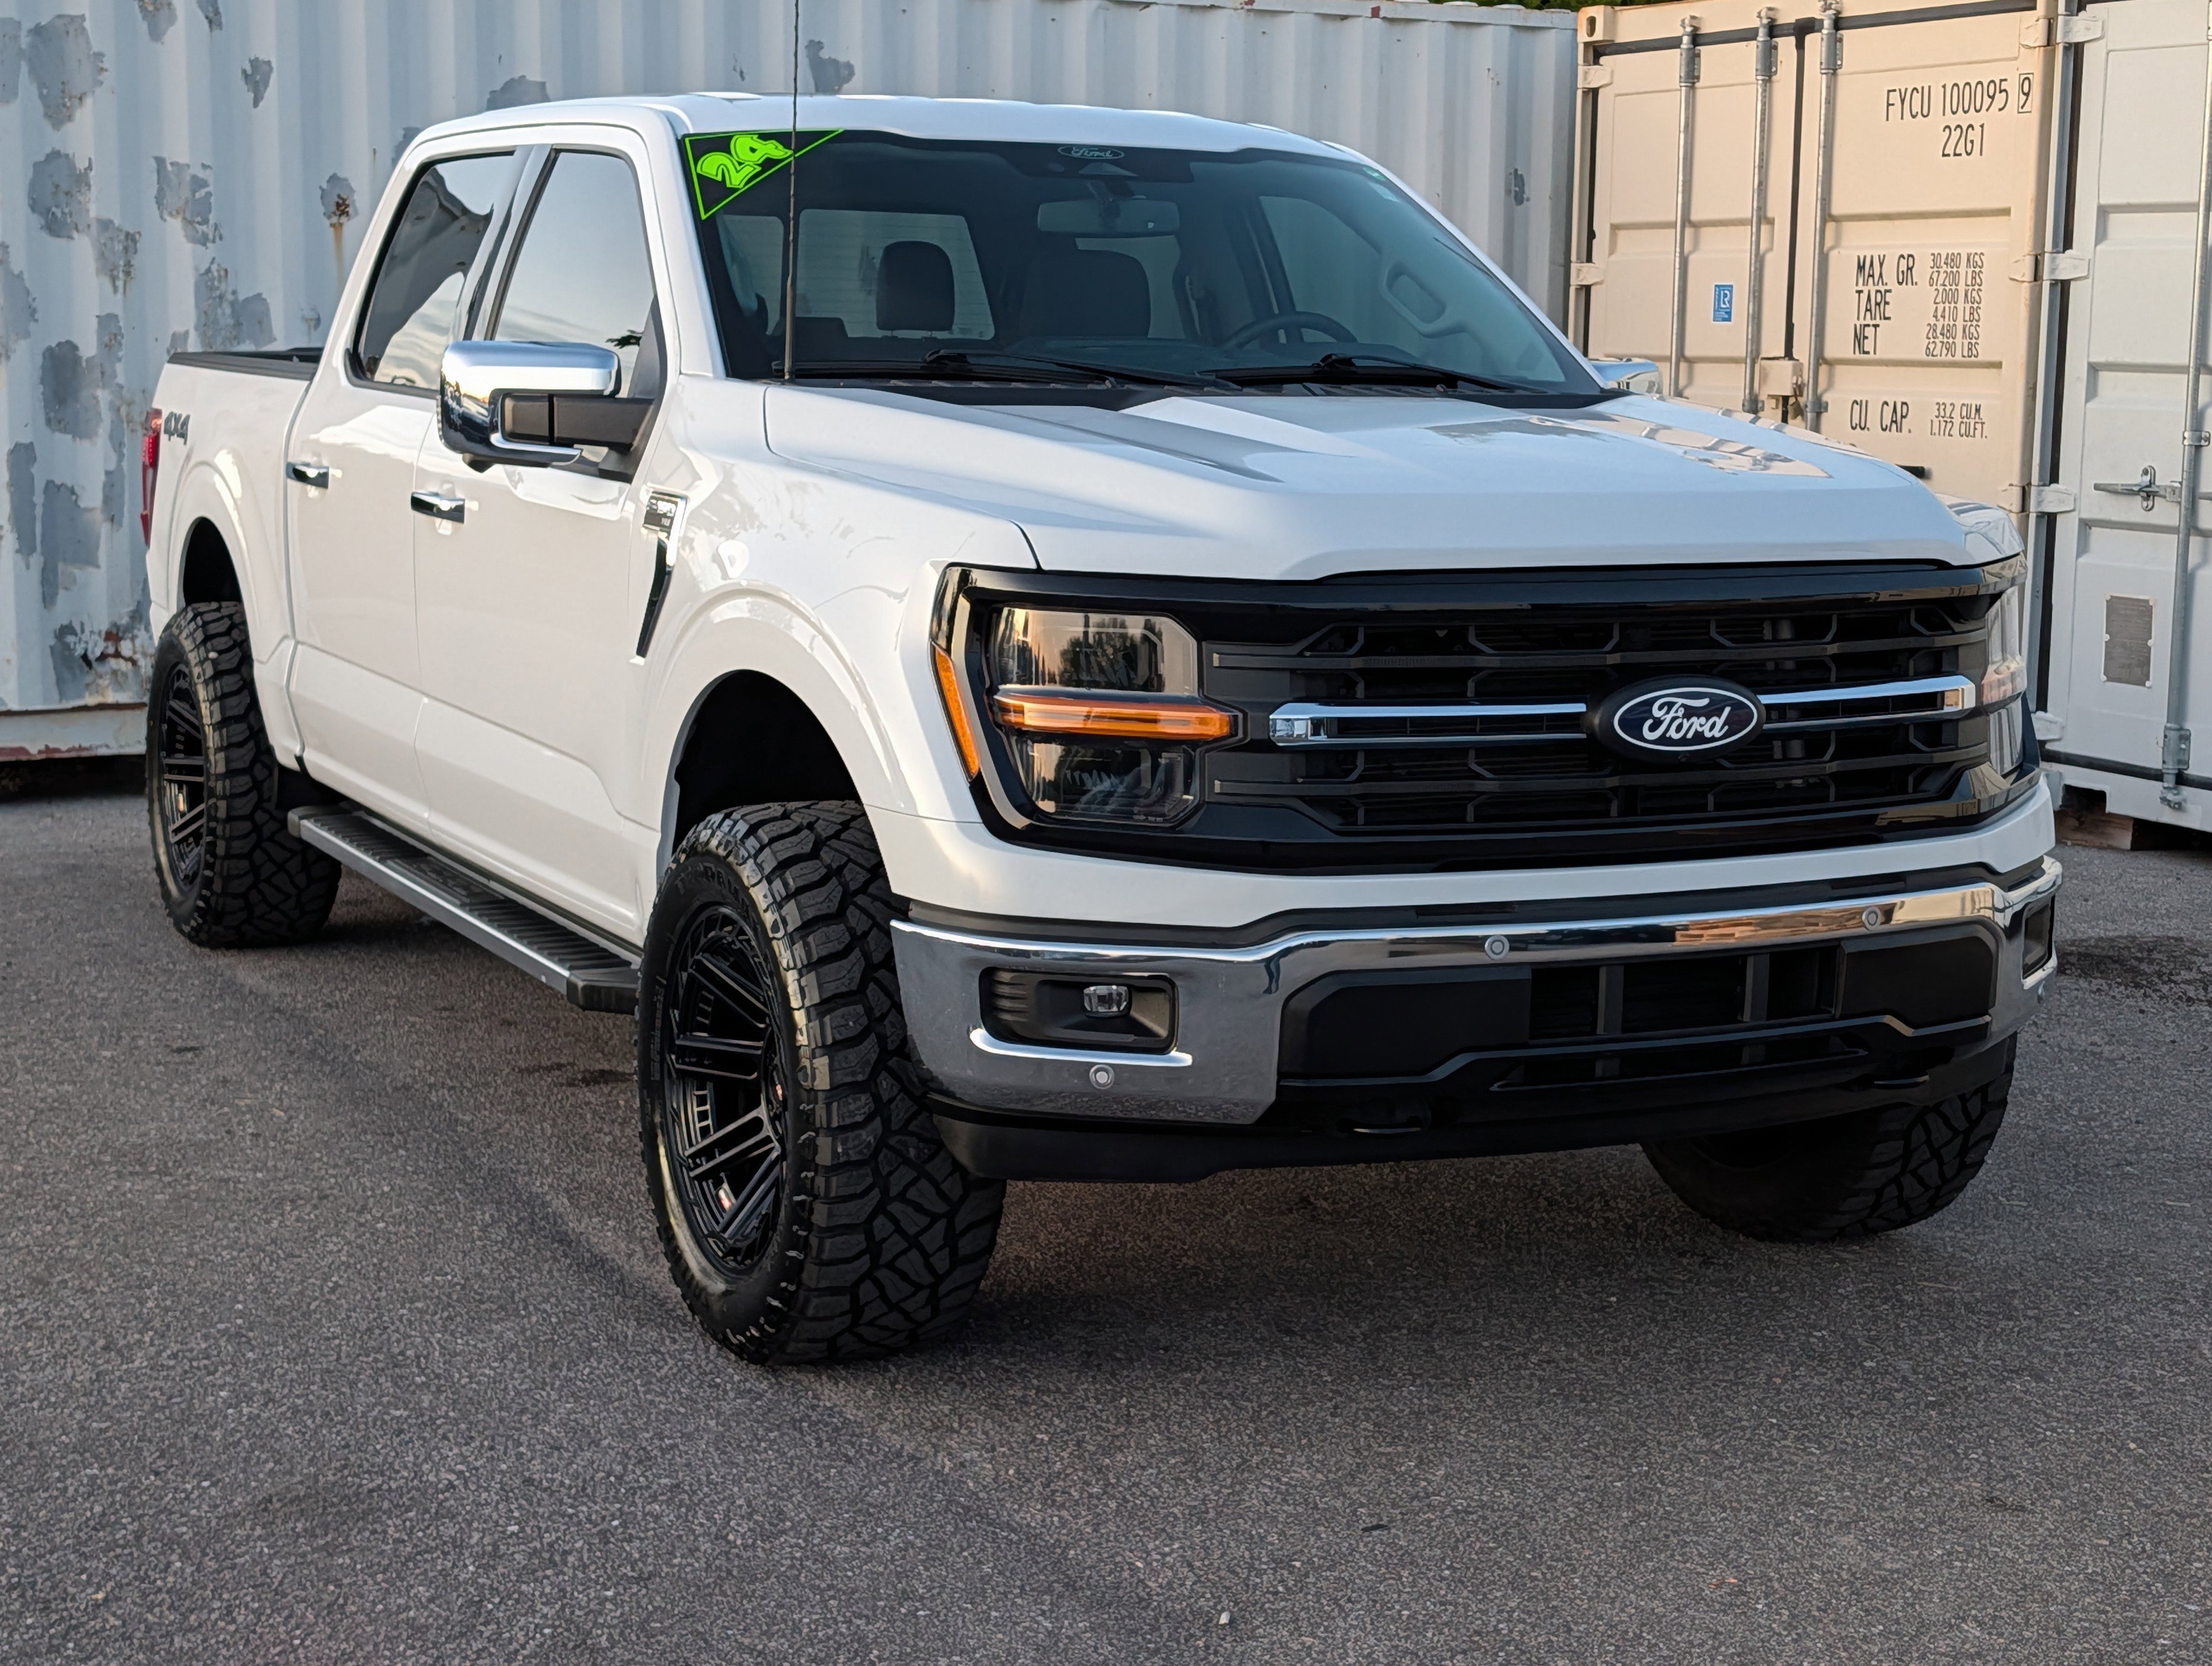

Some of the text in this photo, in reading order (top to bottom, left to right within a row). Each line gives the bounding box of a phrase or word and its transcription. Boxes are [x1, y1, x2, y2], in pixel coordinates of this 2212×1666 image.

[1886, 76, 2031, 121] FYCU 100095 9
[1071, 146, 1114, 157] Ford
[1941, 123, 1985, 157] 22G1
[1855, 252, 1985, 287] MAX. GR. 30.480 KGS
[1965, 270, 1984, 287] LBS
[1855, 289, 1892, 321] TARE
[1964, 288, 1982, 305] KGS
[1963, 306, 1981, 322] LBS
[1853, 323, 1980, 355] NET 28.480 KGS
[1961, 341, 1979, 358] LBS
[1850, 399, 1870, 432] CU.
[1880, 400, 1912, 433] CAP.
[1935, 402, 1955, 419] 33.2
[1642, 696, 1732, 740] Ford
